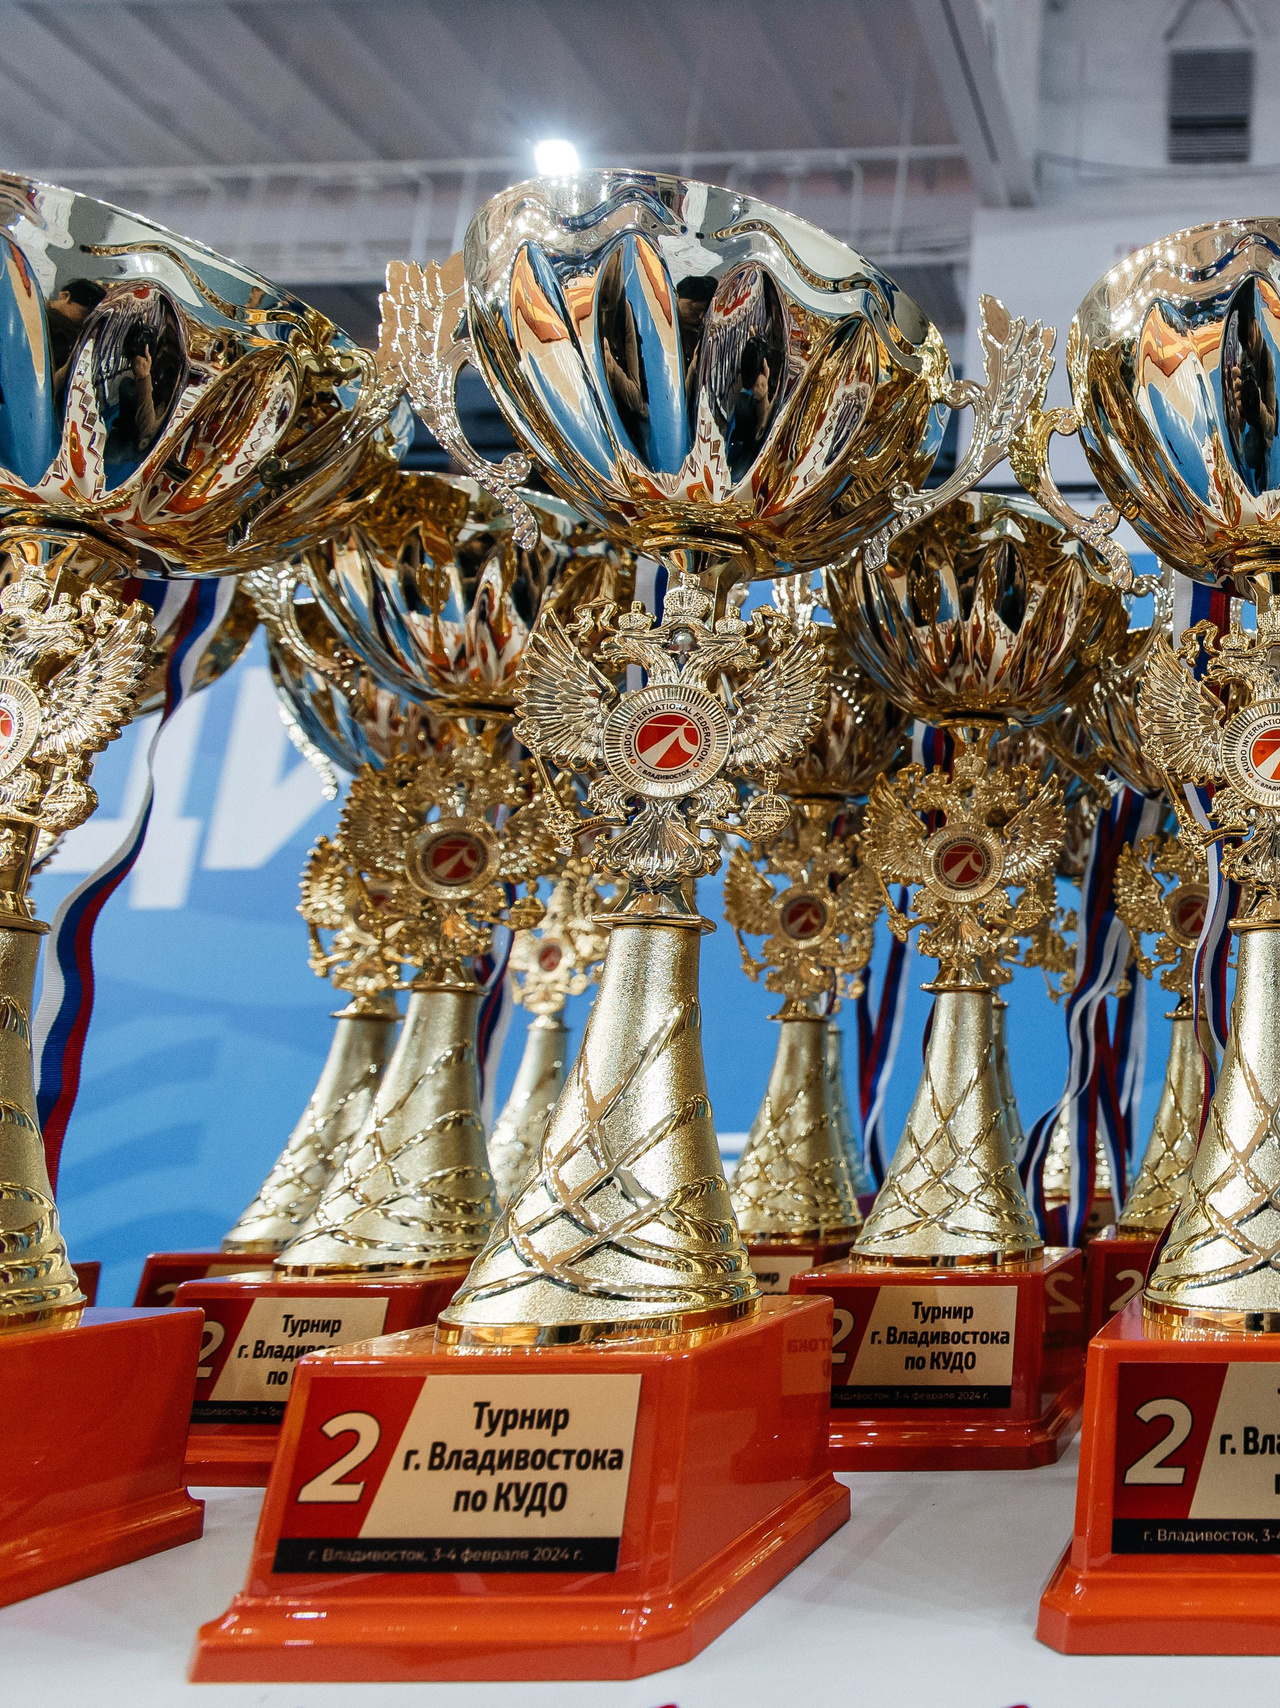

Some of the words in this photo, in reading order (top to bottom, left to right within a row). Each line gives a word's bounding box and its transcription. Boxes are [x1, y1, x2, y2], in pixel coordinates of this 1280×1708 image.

[624, 733, 634, 758] KUDO
[629, 703, 692, 732] INTERNATIONAL
[693, 712, 712, 763] FEDERATION
[1240, 749, 1251, 774] KUDO
[1109, 1269, 1145, 1312] 2
[911, 1301, 974, 1324] Турнир
[282, 1314, 342, 1337] Турнир
[870, 1329, 883, 1345] г.
[886, 1326, 1010, 1348] Владивостока
[237, 1344, 249, 1359] г.
[904, 1354, 926, 1371] по
[929, 1351, 977, 1374] КУДО
[266, 1370, 288, 1386] по
[957, 1391, 981, 1401] 2024
[472, 1401, 570, 1437] Турнир
[1123, 1397, 1194, 1486] 2
[1219, 1433, 1237, 1456] г.
[296, 1410, 382, 1505] 2
[403, 1448, 421, 1472] г.
[428, 1441, 624, 1476] Владивостока
[452, 1489, 487, 1512] по
[493, 1481, 569, 1518] КУДО
[1143, 1531, 1153, 1542] г.
[1157, 1528, 1259, 1544] Владивосток,
[307, 1549, 320, 1563] г.
[322, 1547, 429, 1565] Владивосток,
[431, 1547, 457, 1562] 3-4
[460, 1546, 529, 1565] февраля
[531, 1547, 570, 1562] 2024
[572, 1549, 583, 1563] г.
